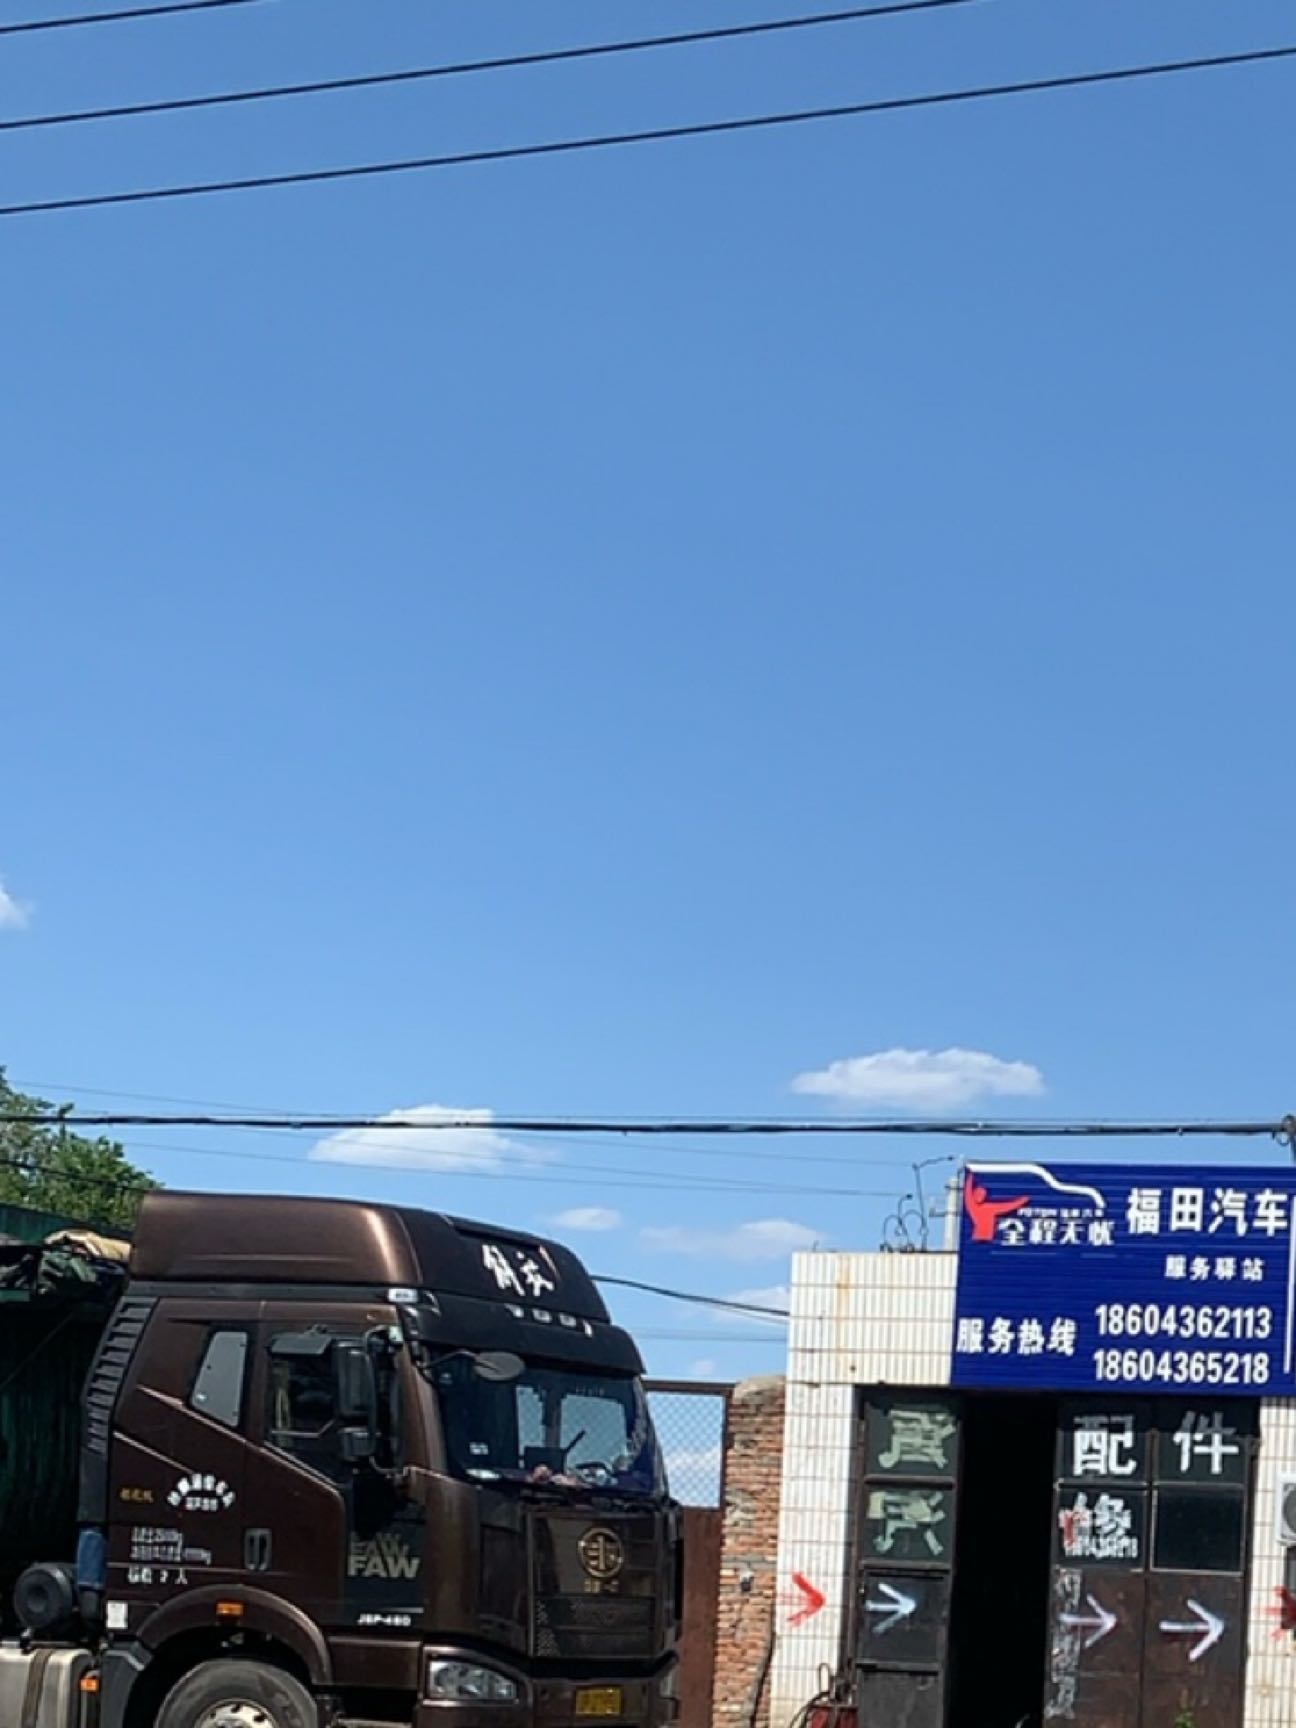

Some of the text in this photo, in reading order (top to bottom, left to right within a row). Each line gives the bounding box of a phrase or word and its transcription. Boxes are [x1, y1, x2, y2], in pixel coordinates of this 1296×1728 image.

[1127, 1187, 1288, 1236] 福田汽车
[956, 1317, 1077, 1356] 服务热线
[1095, 1304, 1272, 1338] 18604362113
[1094, 1349, 1270, 1384] 18604365218
[1073, 1412, 1240, 1477] 配件
